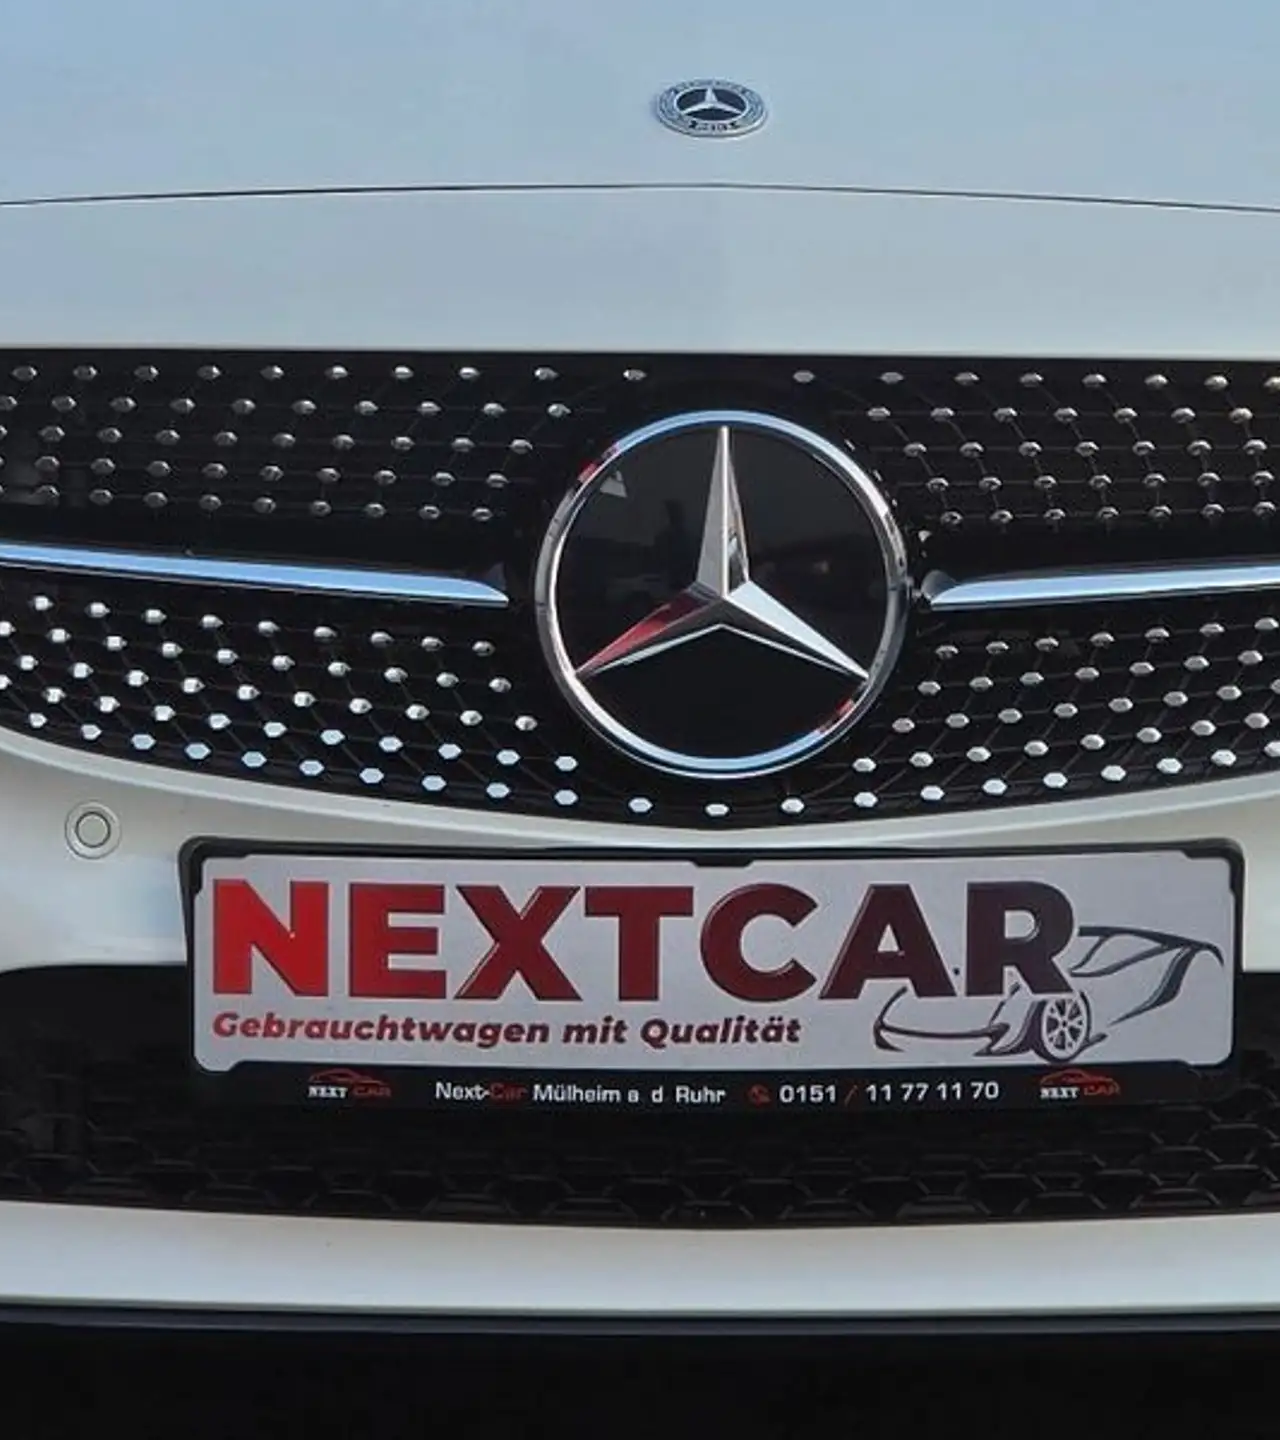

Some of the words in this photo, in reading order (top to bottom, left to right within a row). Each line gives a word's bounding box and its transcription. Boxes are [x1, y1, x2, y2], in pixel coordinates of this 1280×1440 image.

[213, 877, 1074, 1001] NEXTCAR
[212, 1012, 550, 1048] Gebrauchtwagen
[562, 1015, 628, 1044] mit
[640, 1015, 801, 1049] Qualität
[308, 1085, 348, 1098] NEXT
[352, 1086, 391, 1097] CAR
[533, 1084, 620, 1102] Mülheim
[651, 1085, 664, 1103] d
[676, 1085, 726, 1103] Ruhr
[779, 1085, 837, 1103] 0151
[866, 1084, 892, 1102] 11
[901, 1082, 929, 1101] 77
[936, 1082, 962, 1100] 11
[971, 1081, 1000, 1099] 70
[1040, 1086, 1079, 1099] NEXT
